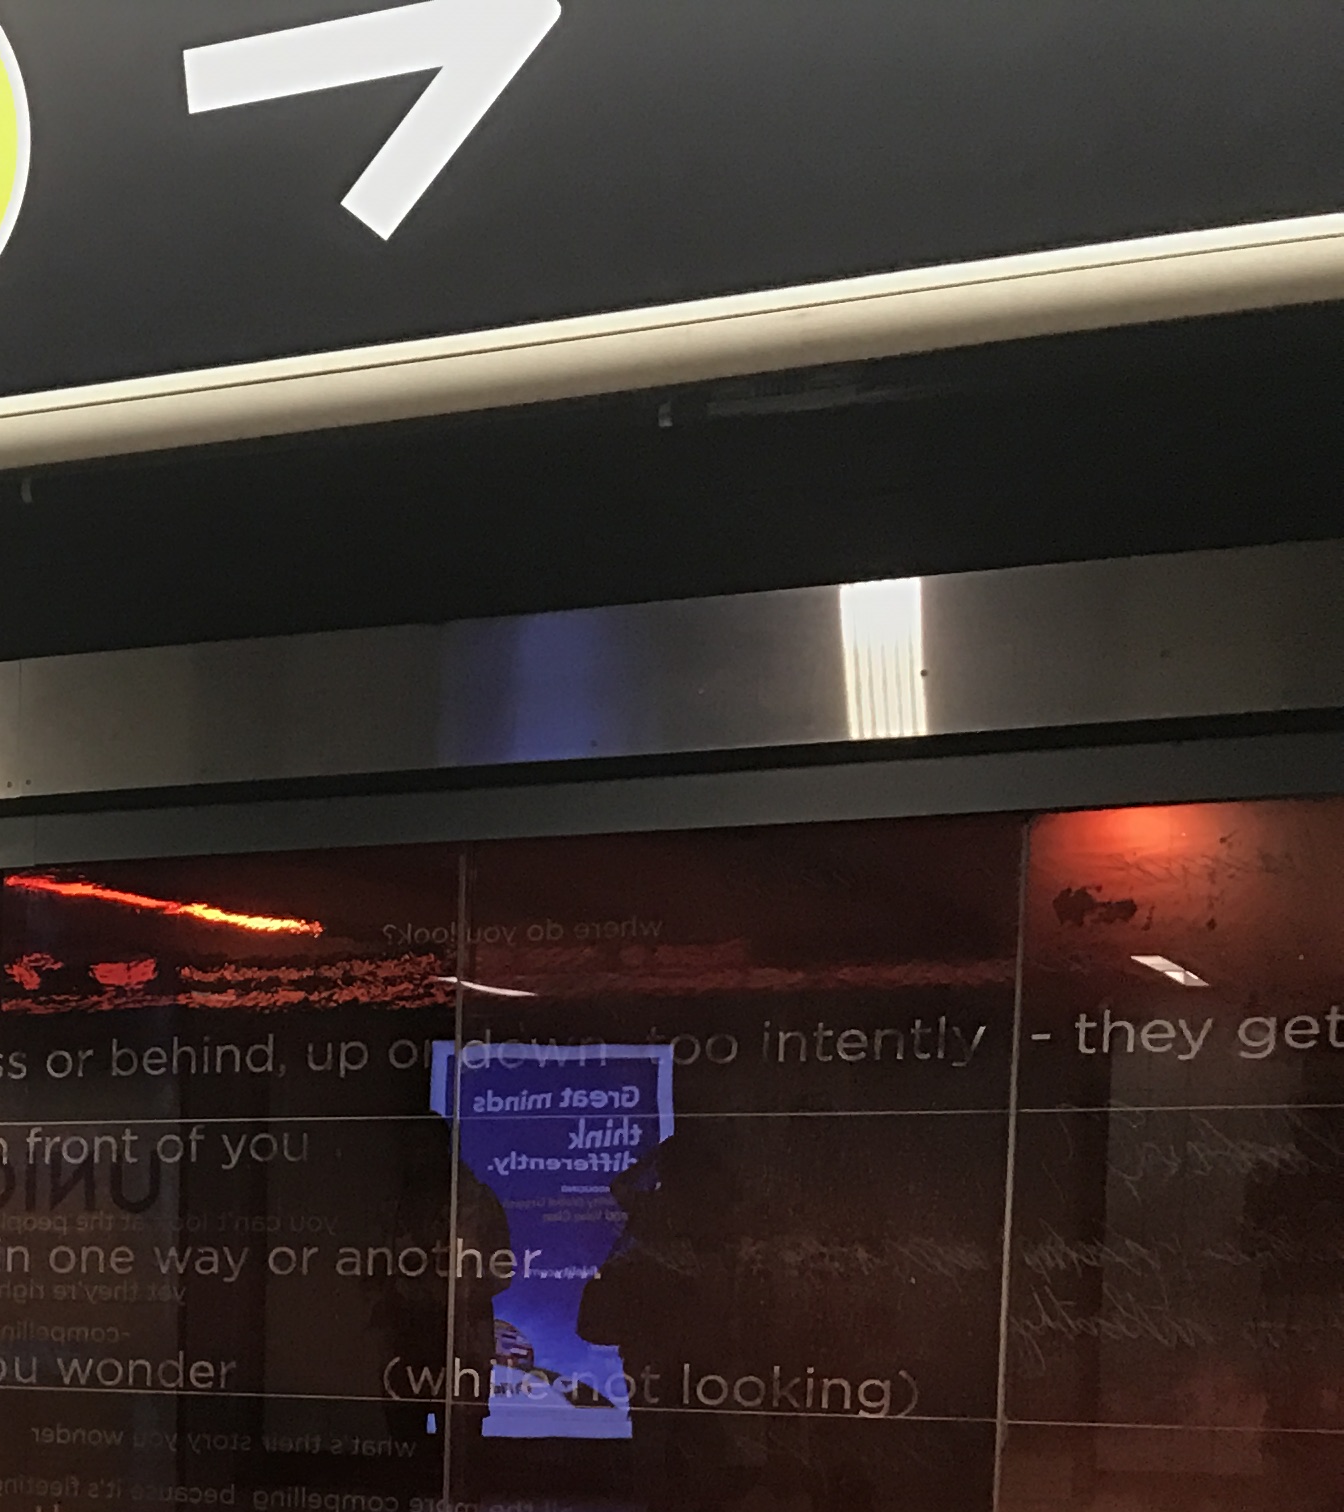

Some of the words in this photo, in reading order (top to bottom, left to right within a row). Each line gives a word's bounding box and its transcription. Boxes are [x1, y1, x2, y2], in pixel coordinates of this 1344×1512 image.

[45, 1046, 94, 1080] or
[111, 1033, 288, 1080] behind,
[307, 1038, 370, 1079] up
[761, 1015, 988, 1069] intently
[1074, 1009, 1213, 1061] they
[1236, 1003, 1344, 1058] get
[25, 1125, 140, 1166] front
[155, 1124, 206, 1165] of
[220, 1130, 310, 1171] you
[48, 1242, 135, 1275] one
[153, 1243, 249, 1284] way
[267, 1243, 319, 1276] or
[56, 1349, 237, 1389] wonder
[682, 1362, 920, 1418] looking)
